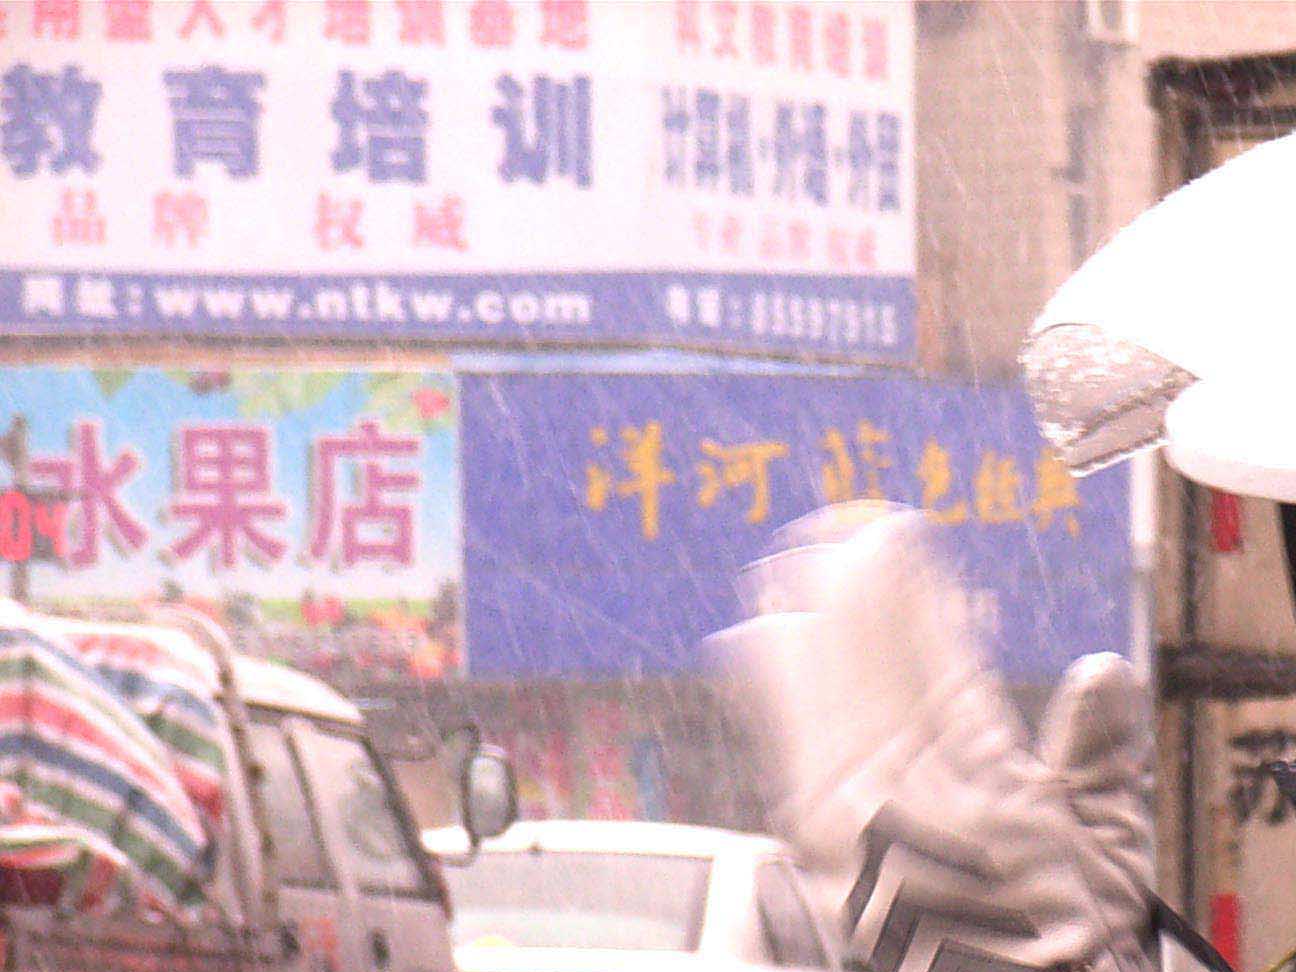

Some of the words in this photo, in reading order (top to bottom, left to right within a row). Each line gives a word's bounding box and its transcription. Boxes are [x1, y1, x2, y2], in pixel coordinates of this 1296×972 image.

[0, 64, 592, 188] 教育培训
[50, 188, 208, 248] 品牌
[312, 193, 470, 252] 权威
[25, 420, 422, 568] 水果店
